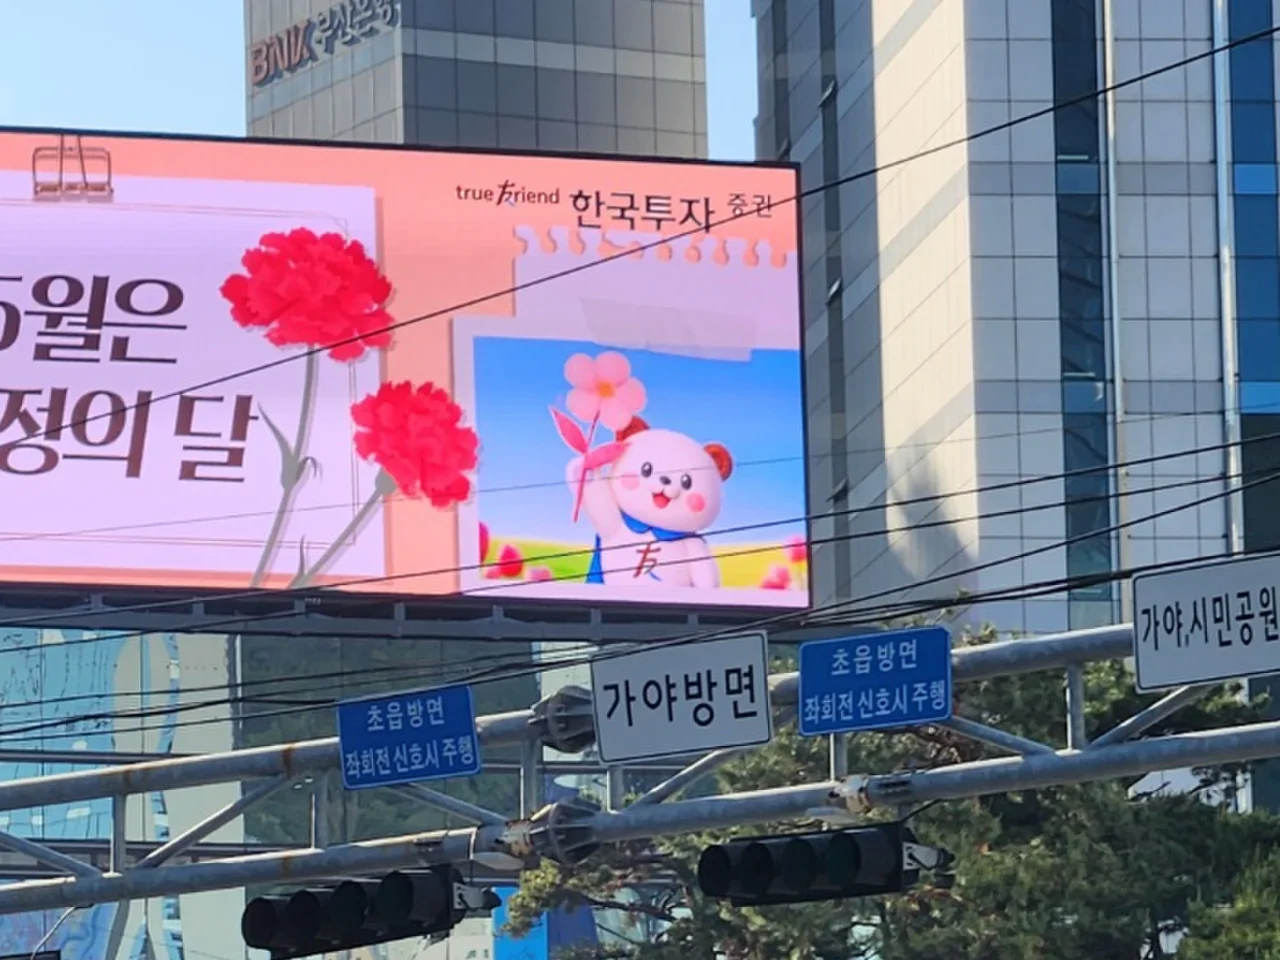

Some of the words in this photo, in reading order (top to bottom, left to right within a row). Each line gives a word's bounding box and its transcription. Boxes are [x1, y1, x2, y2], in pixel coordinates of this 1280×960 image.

[251, 19, 317, 86] BNK
[569, 190, 714, 233] 한국투자
[727, 193, 772, 218] 증권
[173, 392, 260, 483] 달
[831, 639, 918, 675] 초읍방면
[367, 697, 445, 732] 초읍방면
[603, 664, 758, 727] 가야방면
[912, 680, 946, 713] 주행
